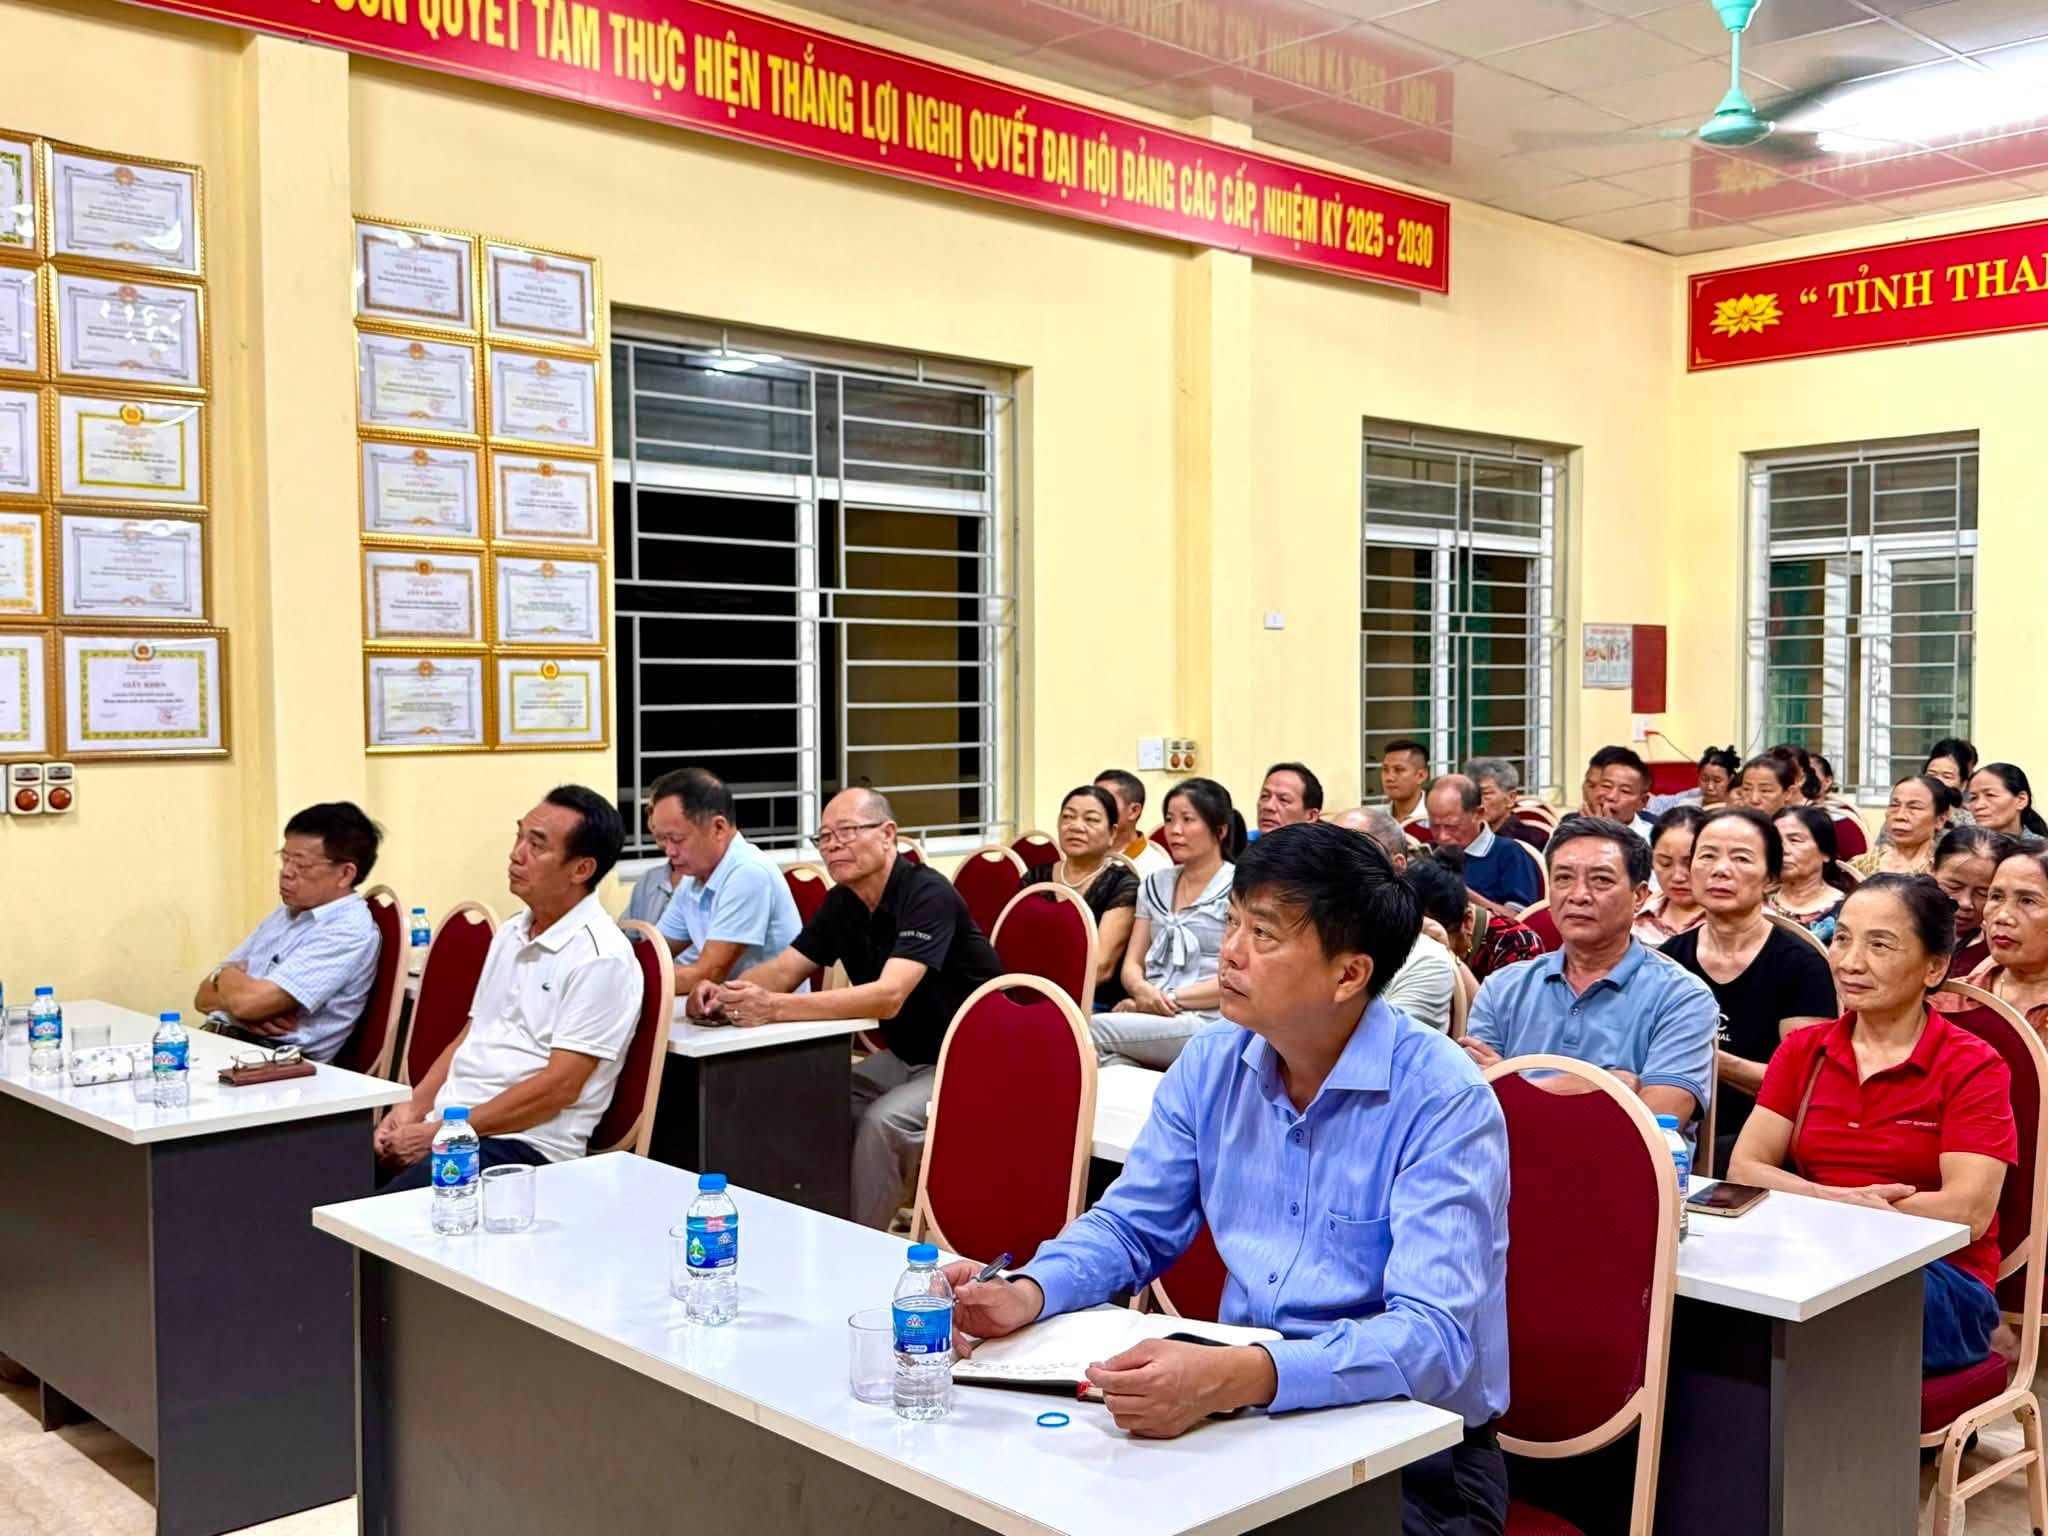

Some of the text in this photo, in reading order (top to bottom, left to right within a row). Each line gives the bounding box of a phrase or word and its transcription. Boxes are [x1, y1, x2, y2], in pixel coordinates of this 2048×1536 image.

[609, 13, 686, 101] THỰC
[695, 30, 761, 118] HIỆN
[767, 43, 855, 135] THẮNG
[861, 80, 900, 156] LỢI
[906, 92, 963, 173] NGHỊ
[969, 105, 1037, 178] QUYẾT
[1042, 128, 1078, 198] ĐẠI
[1083, 131, 1117, 207] HỘI
[1122, 136, 1175, 211] ĐẢNG
[1180, 160, 1217, 220] CÁC
[1222, 162, 1259, 237] CẤP,
[1263, 183, 1318, 251] NHIỆM
[1322, 192, 1343, 249] KỲ
[1346, 208, 1384, 258] 2025
[1397, 218, 1433, 269] 2030
[1828, 263, 1934, 318] TỈNH
